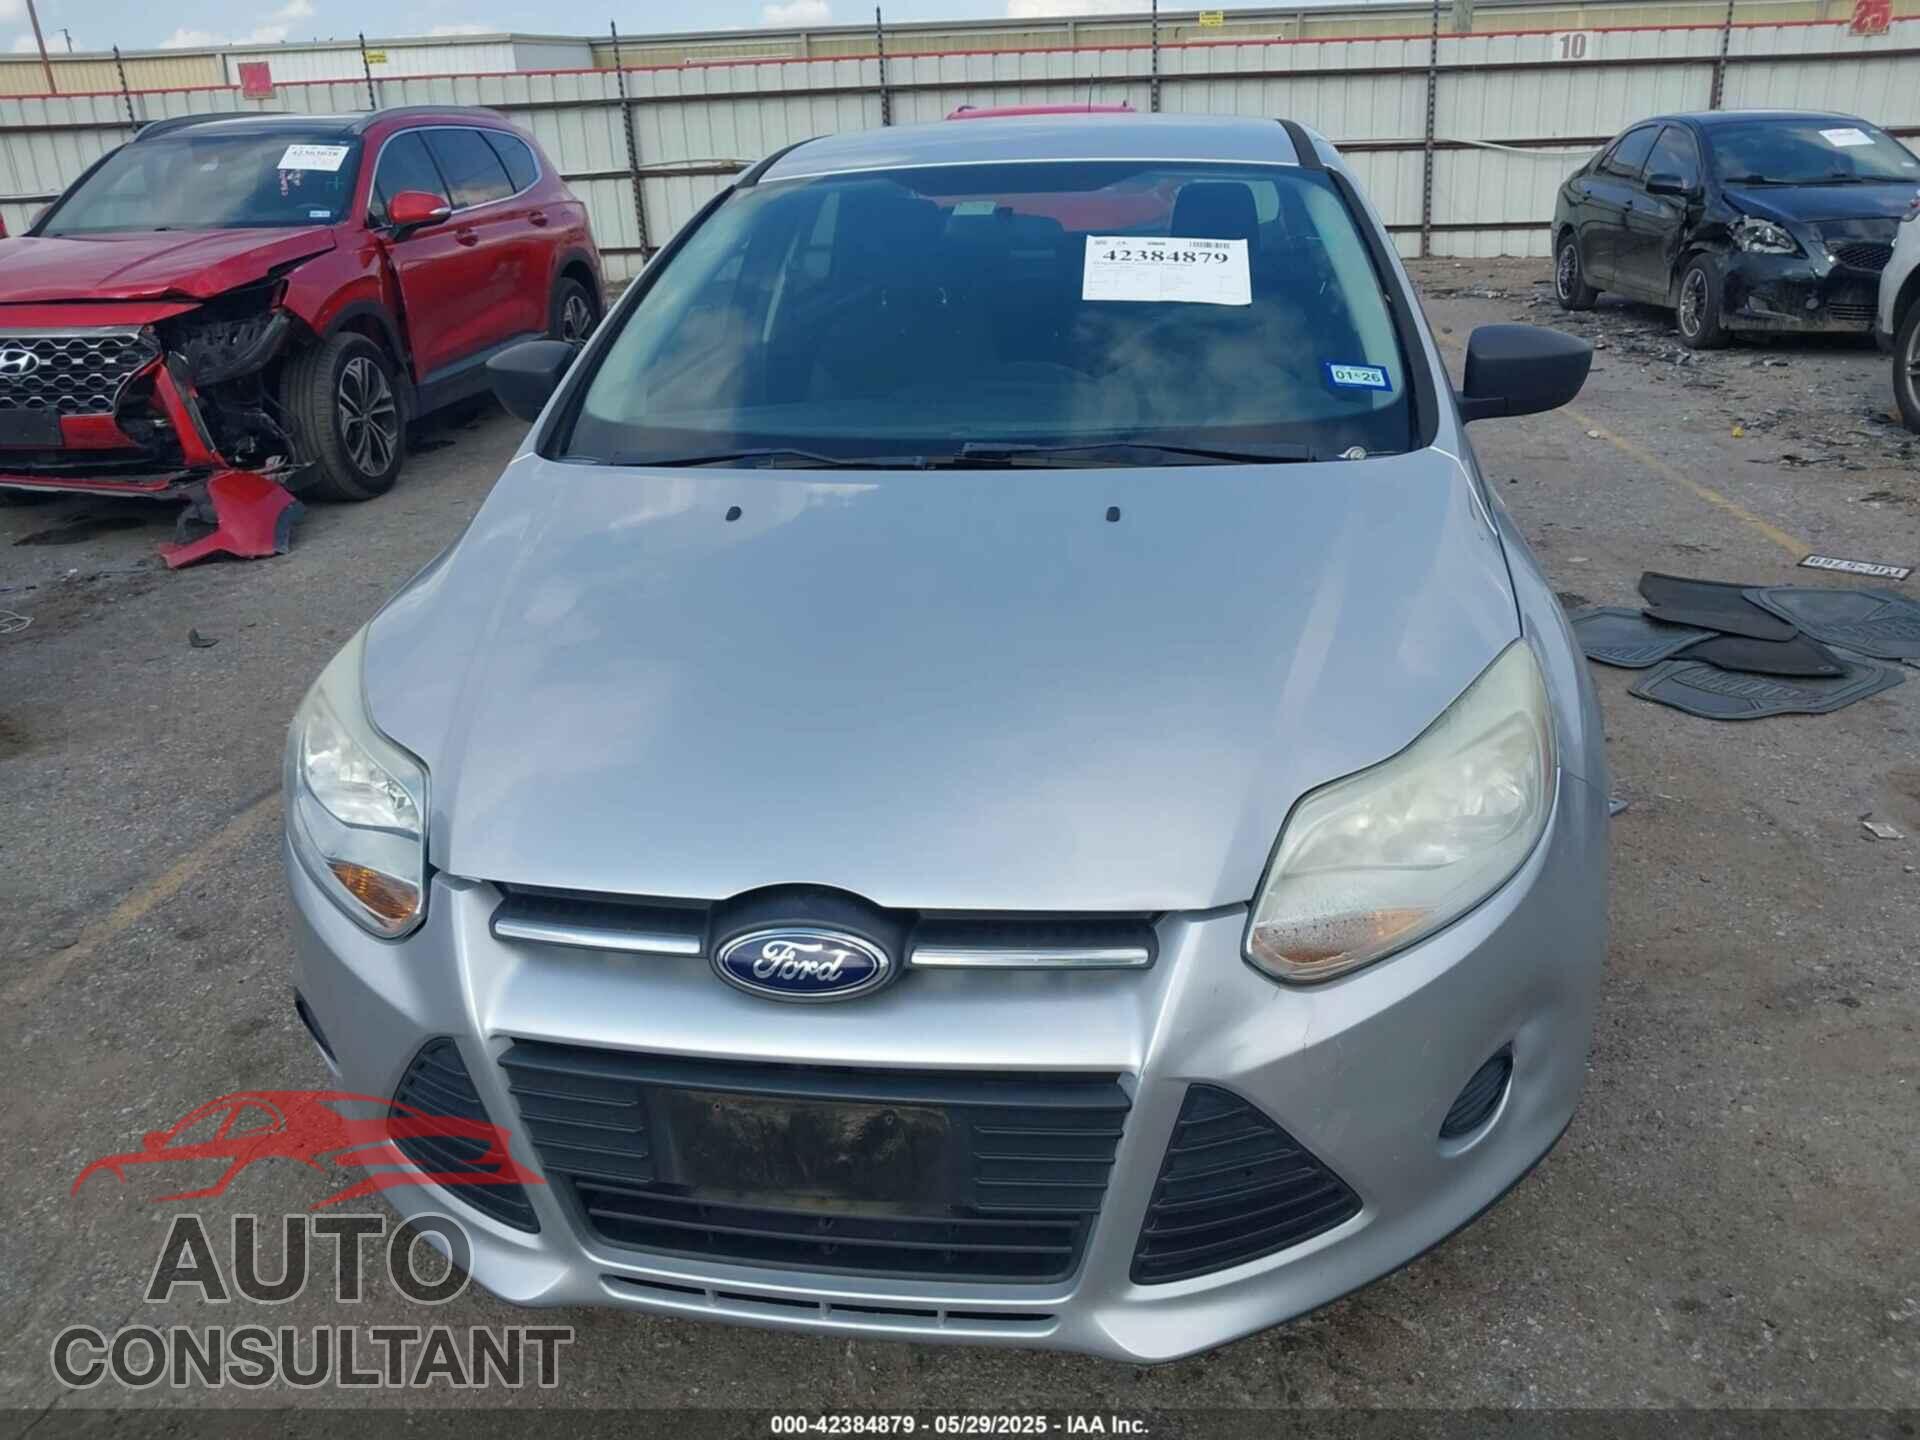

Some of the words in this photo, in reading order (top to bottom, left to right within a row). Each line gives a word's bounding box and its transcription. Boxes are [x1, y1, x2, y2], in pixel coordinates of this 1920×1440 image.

[1560, 33, 1586, 59] 10
[1102, 249, 1229, 264] 42384879
[753, 940, 850, 981] Ford
